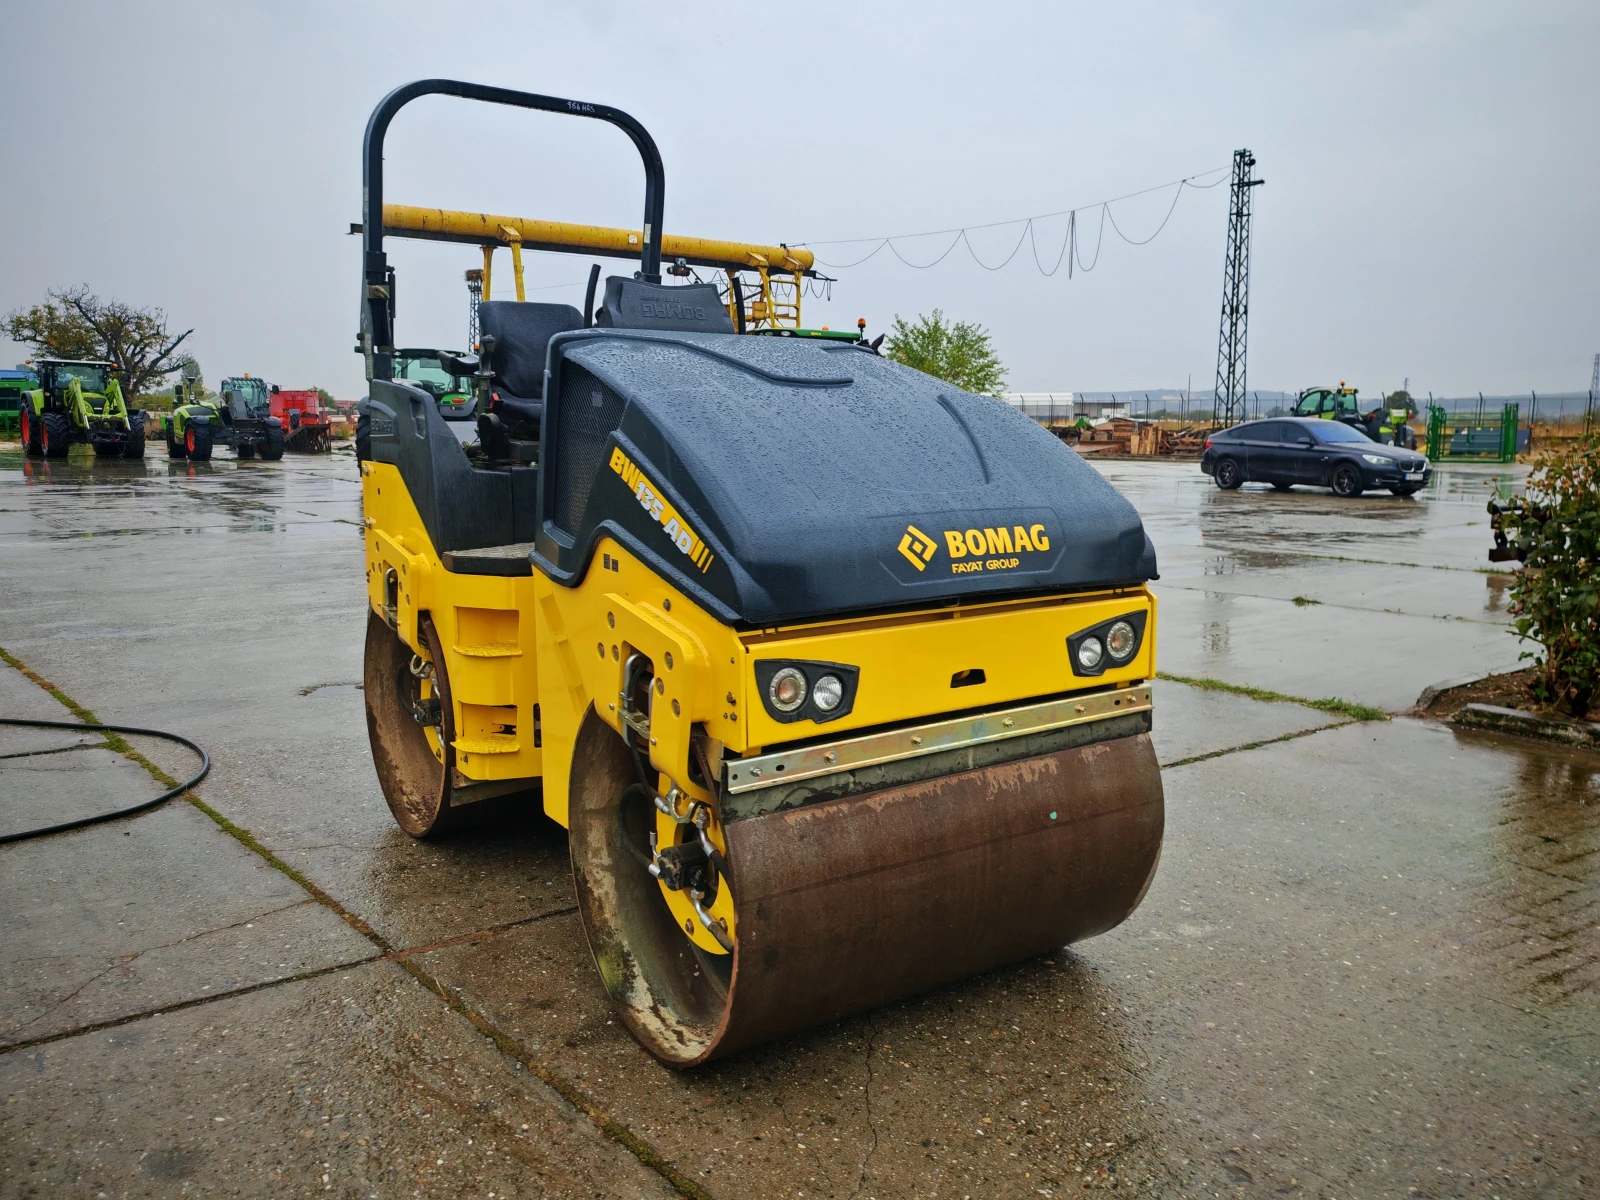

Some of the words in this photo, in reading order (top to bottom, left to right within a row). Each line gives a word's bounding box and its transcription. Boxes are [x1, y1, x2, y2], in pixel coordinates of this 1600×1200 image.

[581, 103, 595, 113] HRS
[641, 302, 706, 321] BOMAG
[943, 523, 1051, 559] BOMAG
[951, 560, 984, 574] FAYAT
[985, 557, 1020, 571] GROUP
